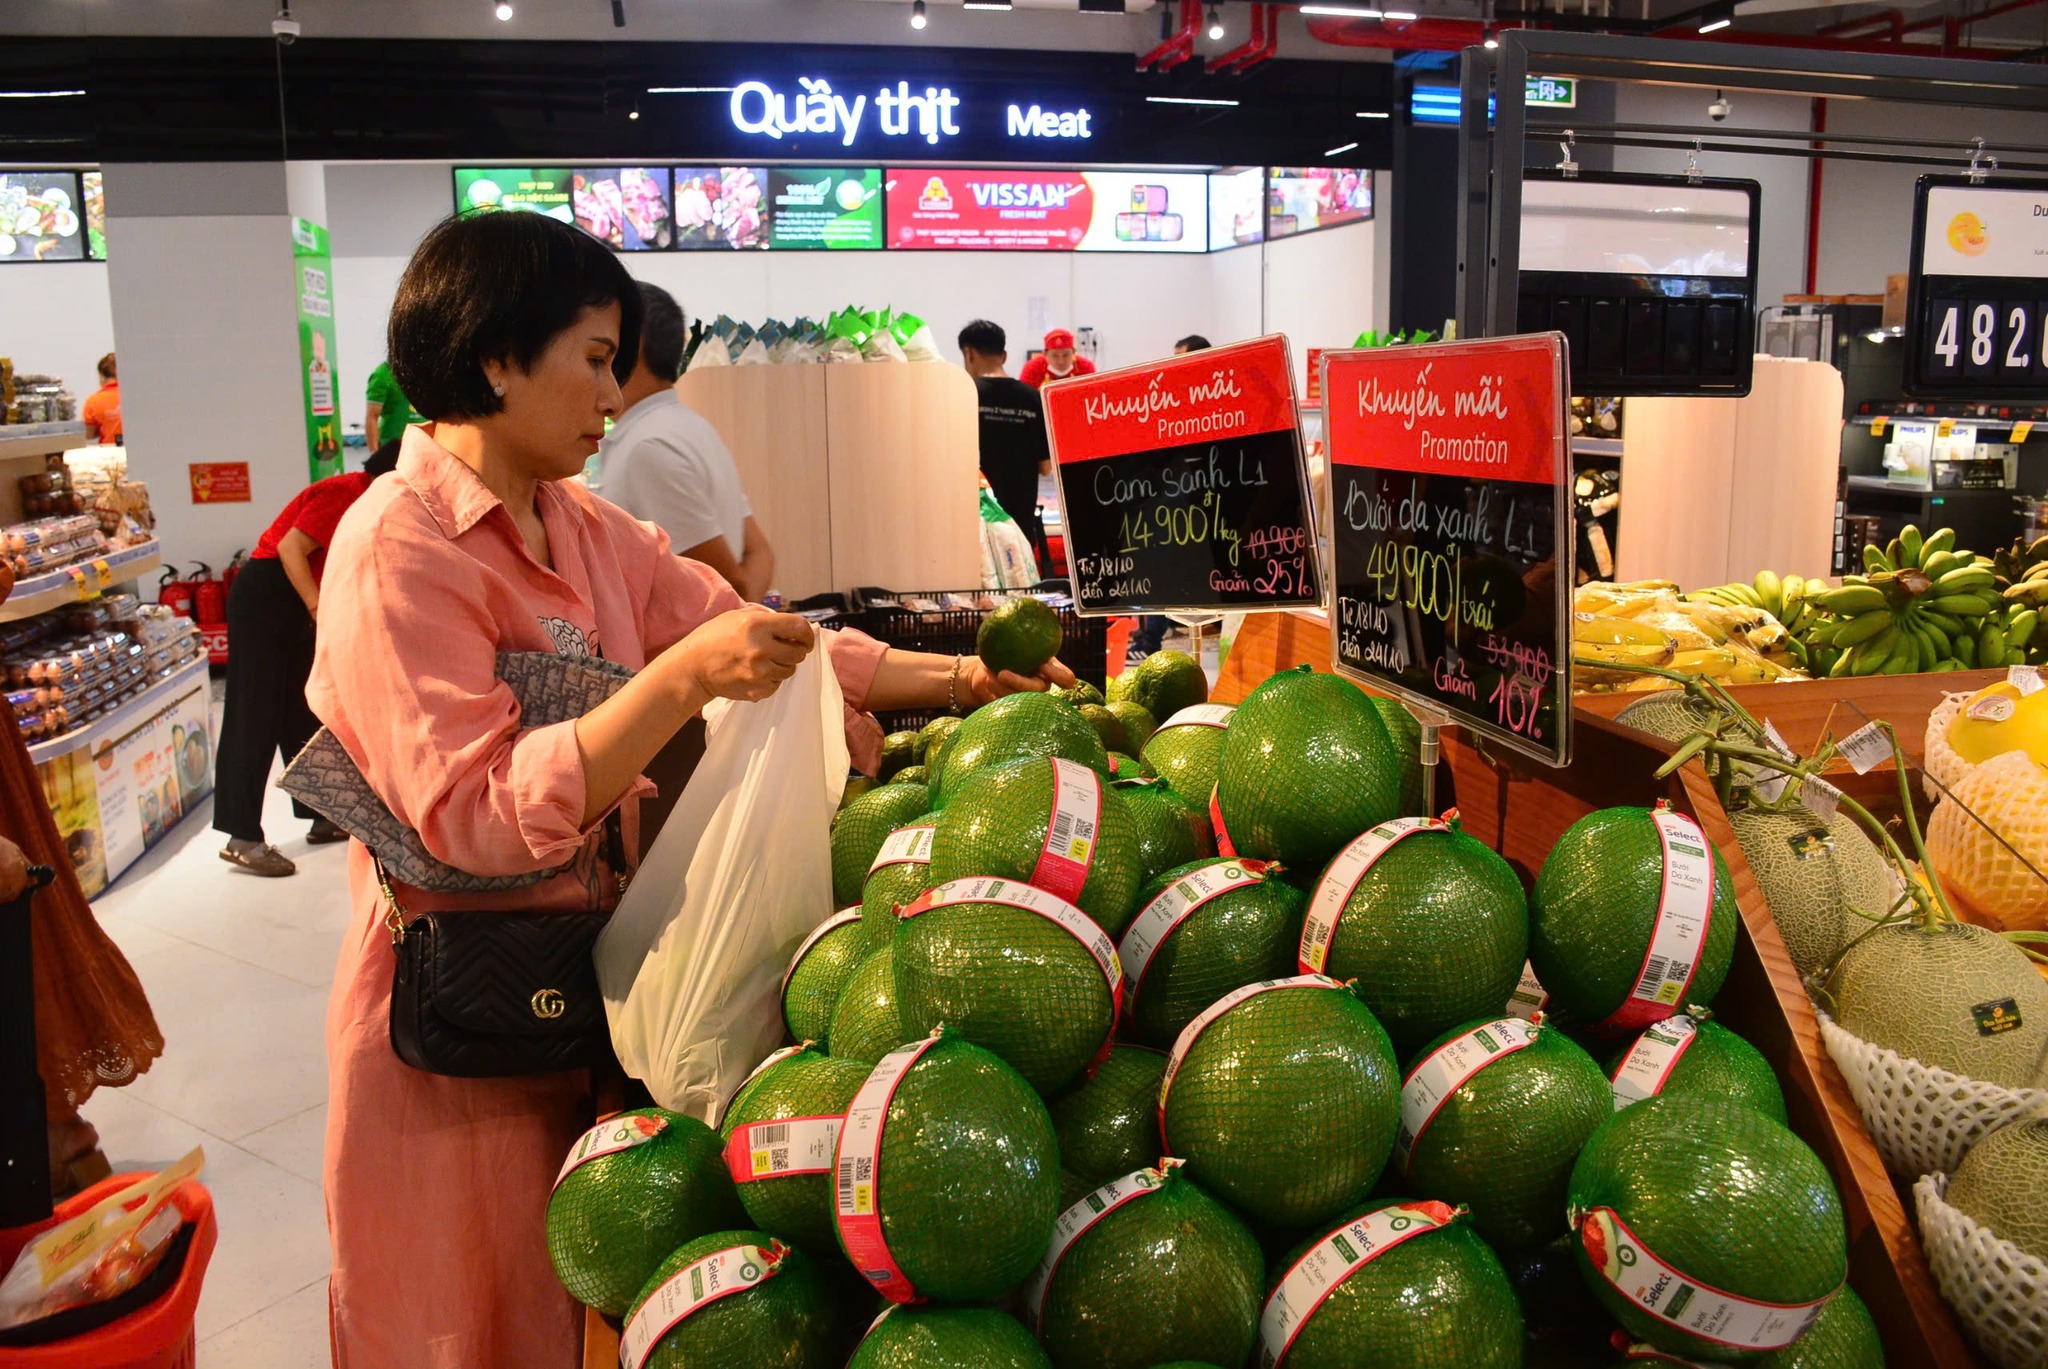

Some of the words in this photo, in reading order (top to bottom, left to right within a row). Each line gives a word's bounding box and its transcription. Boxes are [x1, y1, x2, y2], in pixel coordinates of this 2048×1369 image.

[730, 77, 866, 146] Quầy
[875, 80, 960, 144] thịt
[1007, 104, 1092, 138] Meat
[1084, 372, 1180, 425] Khuyến
[1189, 368, 1242, 405] mãi
[1358, 362, 1446, 430] Khuyến
[1455, 375, 1509, 420] mãi
[1158, 409, 1246, 440] Promotion
[1420, 429, 1509, 465] Promotion
[1094, 464, 1158, 506] Cam
[1435, 485, 1492, 544] xanh
[1098, 556, 1134, 577] 18/10
[1209, 570, 1250, 593] Giảm
[1254, 556, 1313, 597] 25%
[1081, 577, 1104, 600] đến
[1109, 577, 1152, 598] 24/10
[1364, 640, 1404, 674] 24/10
[1434, 656, 1476, 701] Giảm
[1488, 673, 1545, 738] 10%
[1665, 828, 1702, 843] Select
[1191, 873, 1213, 894] Select
[1349, 1223, 1375, 1252] Select
[708, 1258, 720, 1292] Select
[1643, 1272, 1672, 1307] Select
